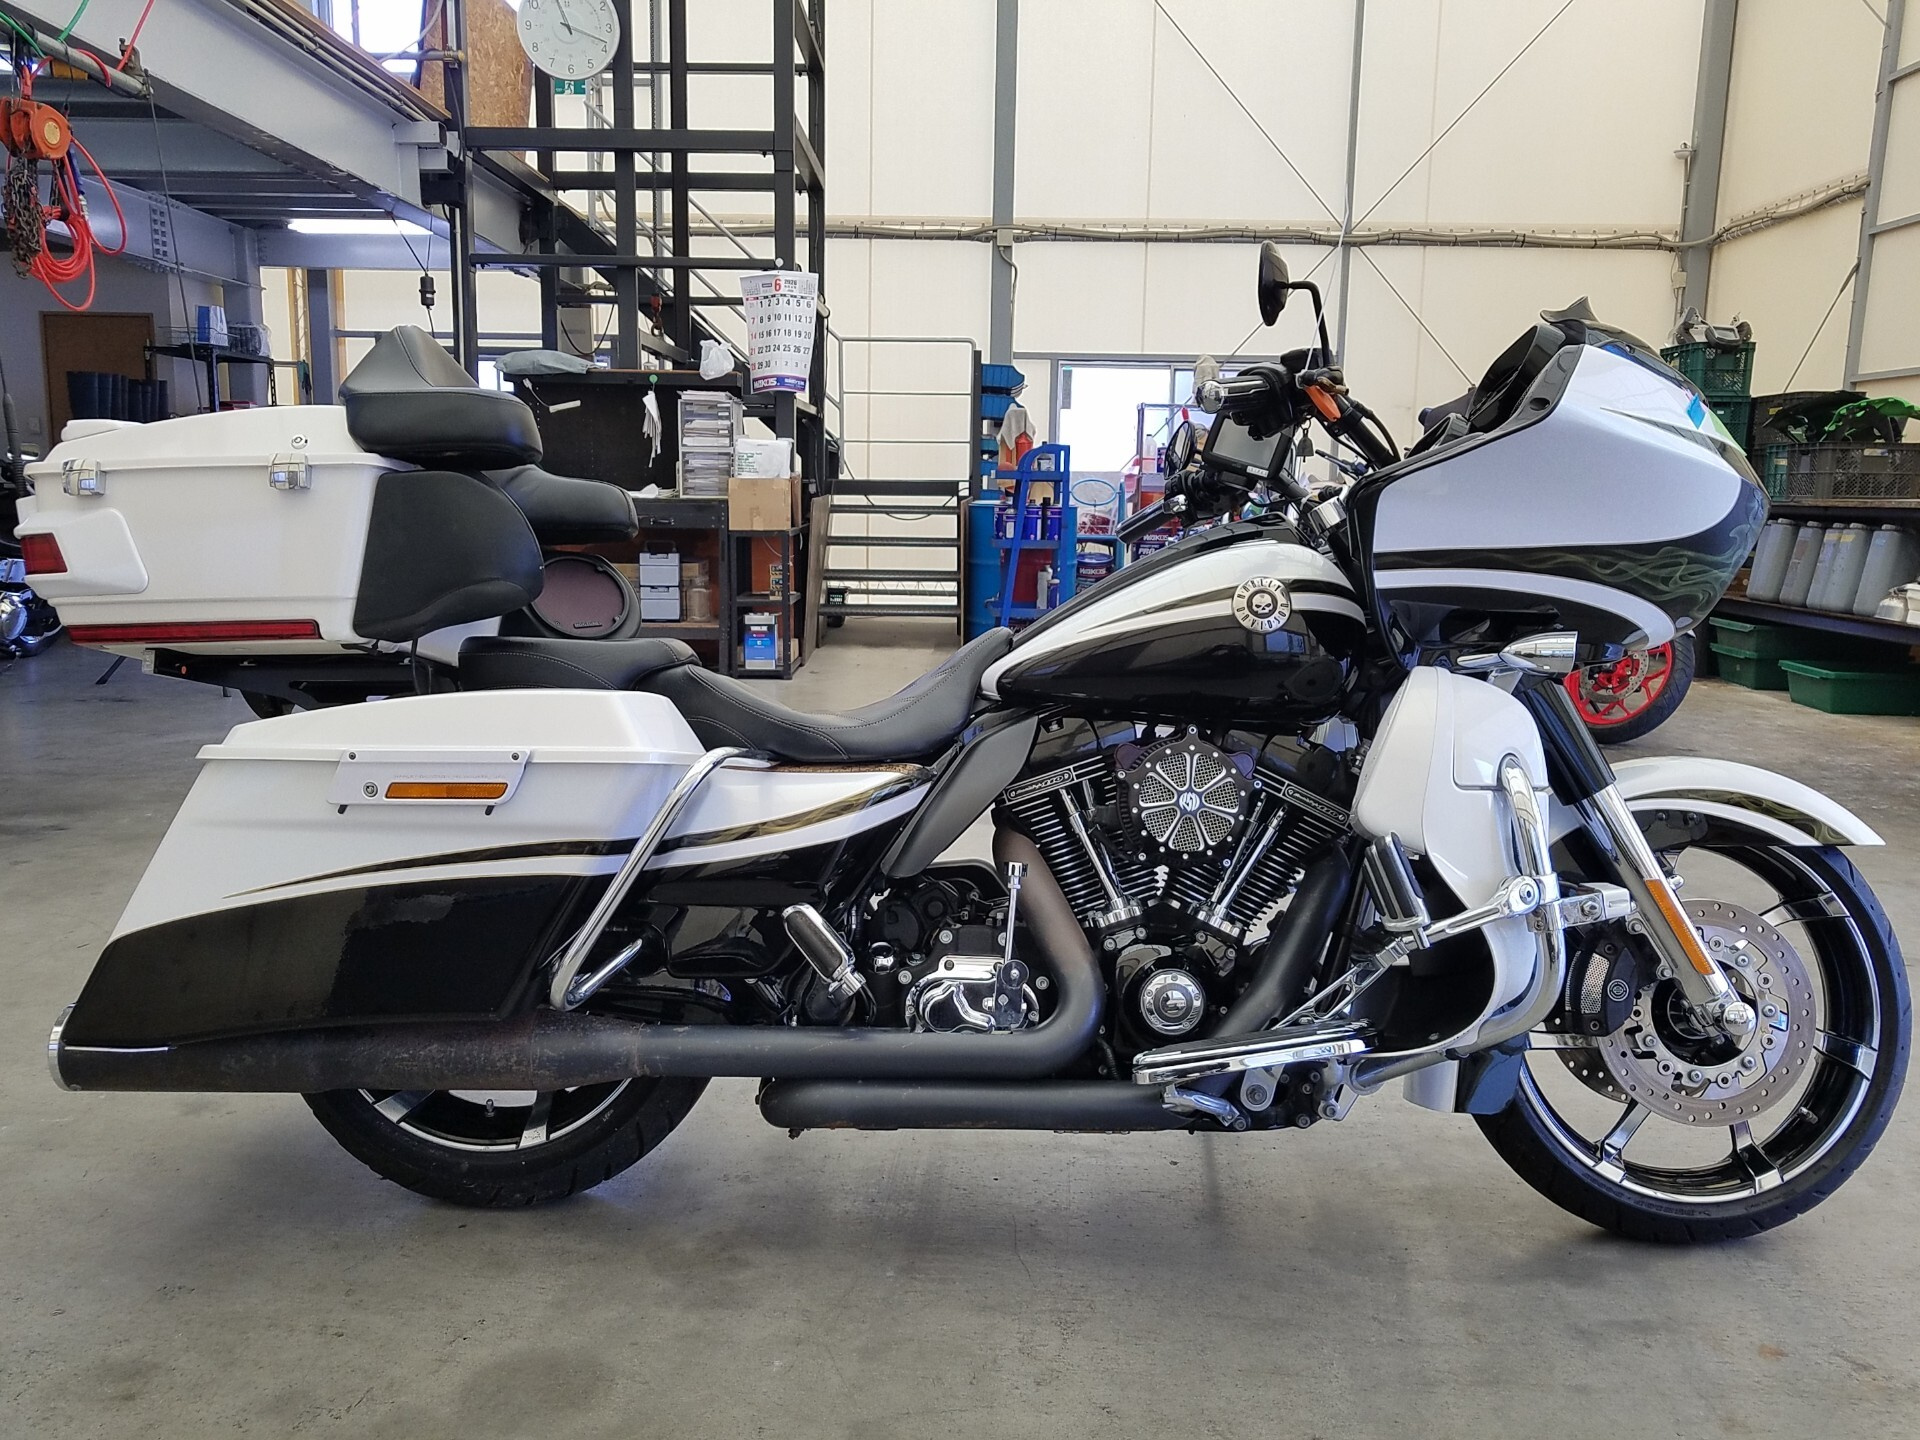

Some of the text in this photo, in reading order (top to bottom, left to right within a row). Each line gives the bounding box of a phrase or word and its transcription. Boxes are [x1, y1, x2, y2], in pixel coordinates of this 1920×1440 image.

[599, 2, 606, 11] 2
[525, 20, 532, 30] 9
[605, 24, 612, 33] 3
[532, 42, 538, 52] 8
[601, 45, 607, 54] 4
[549, 58, 555, 67] 7
[588, 59, 594, 68] 5
[568, 64, 574, 74] 6
[774, 278, 781, 292] 6
